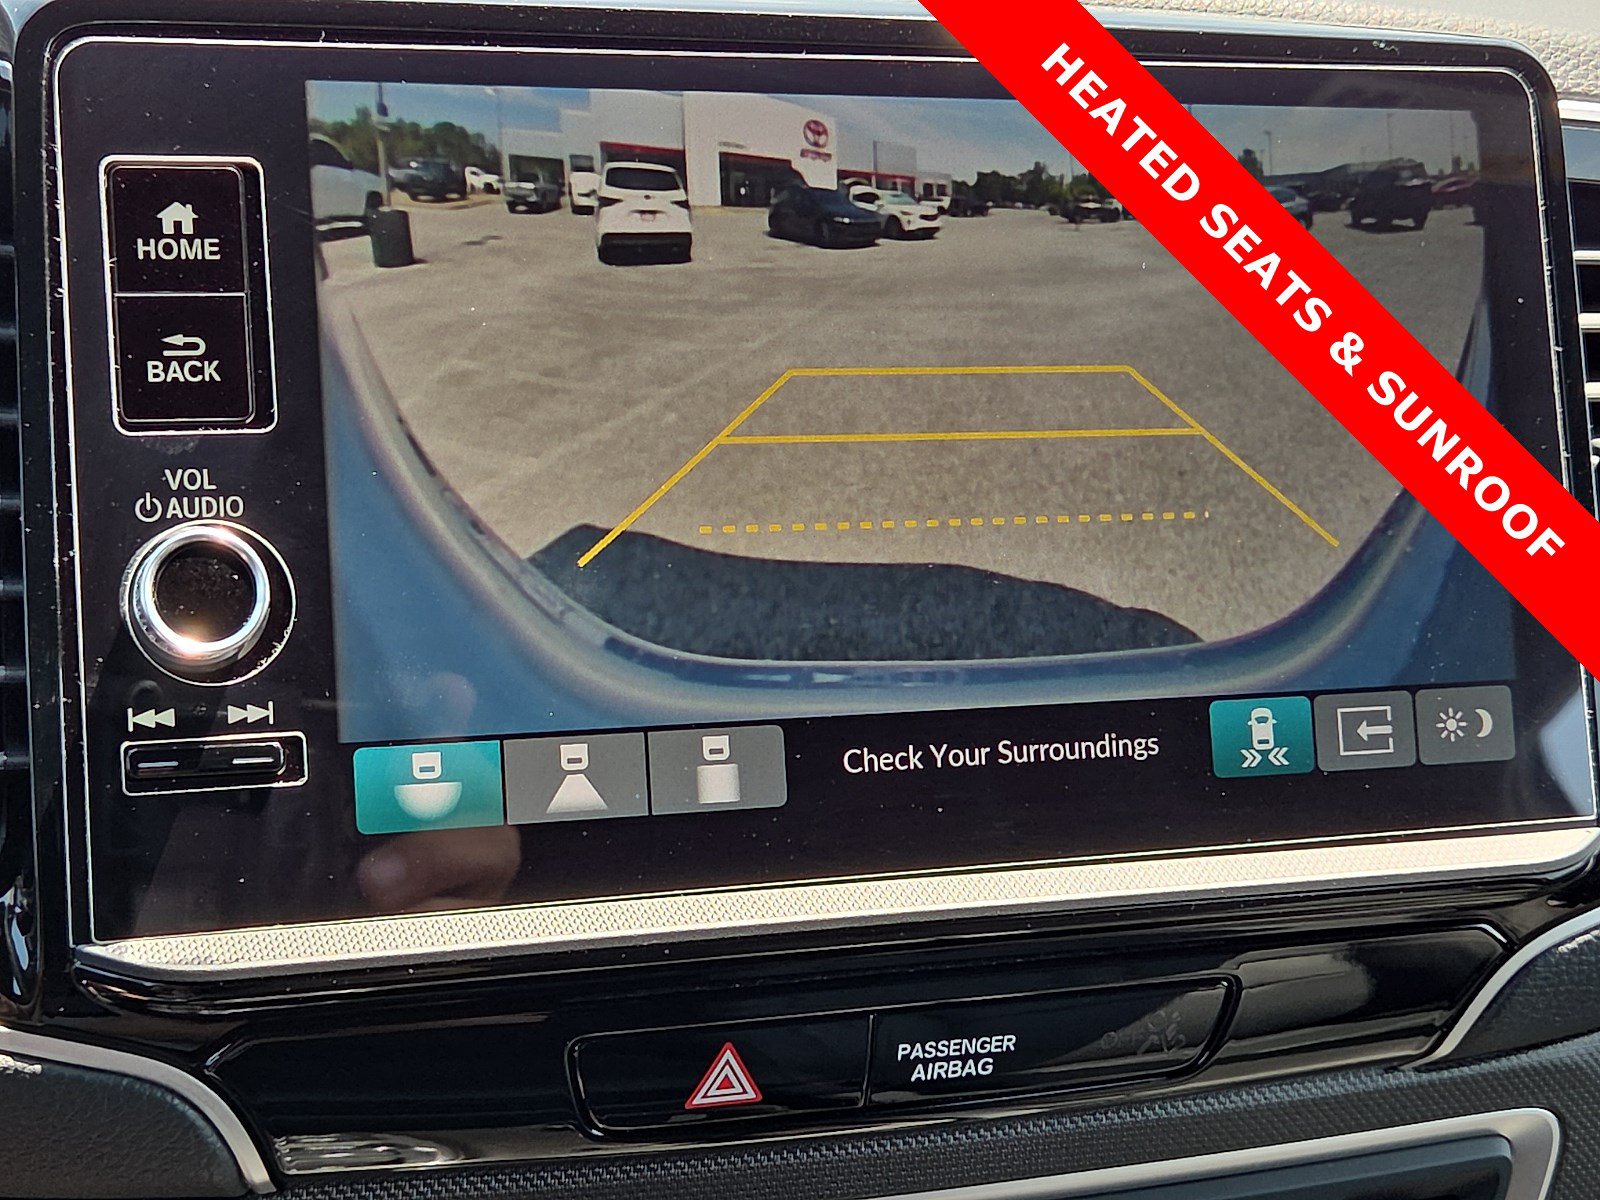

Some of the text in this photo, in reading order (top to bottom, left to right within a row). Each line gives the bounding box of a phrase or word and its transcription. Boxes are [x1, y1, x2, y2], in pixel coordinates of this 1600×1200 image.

[136, 238, 221, 260] HOME
[147, 360, 221, 382] BACK
[164, 468, 217, 490] VOL
[166, 495, 244, 519] AUDIO
[843, 733, 1159, 774] Check Your Surroundings
[897, 1035, 1017, 1061] PASSENGER
[910, 1057, 994, 1082] AIRBAG
